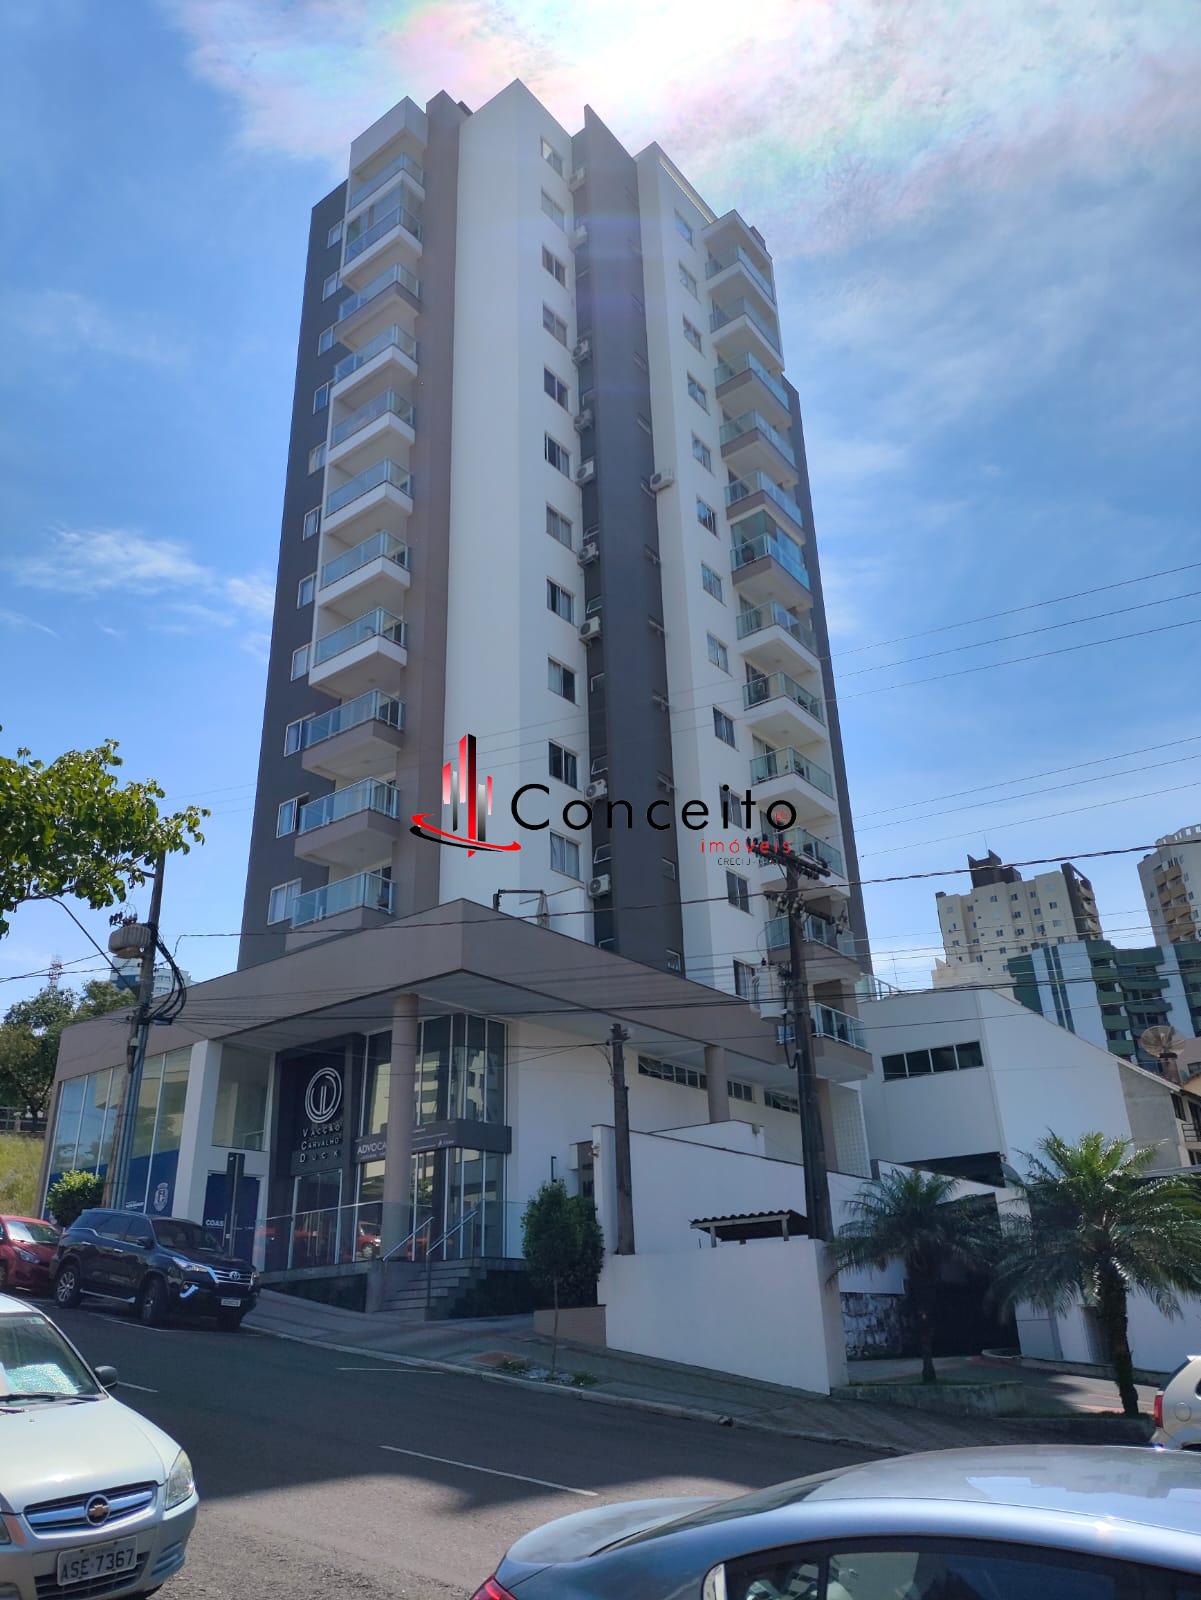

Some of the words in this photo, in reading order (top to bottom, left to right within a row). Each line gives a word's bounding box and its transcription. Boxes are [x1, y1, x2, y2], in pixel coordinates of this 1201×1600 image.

[301, 1137, 339, 1150] CARVALHO
[300, 1150, 338, 1163] DUCK
[61, 1558, 89, 1580] ASE
[96, 1549, 134, 1572] 7367
